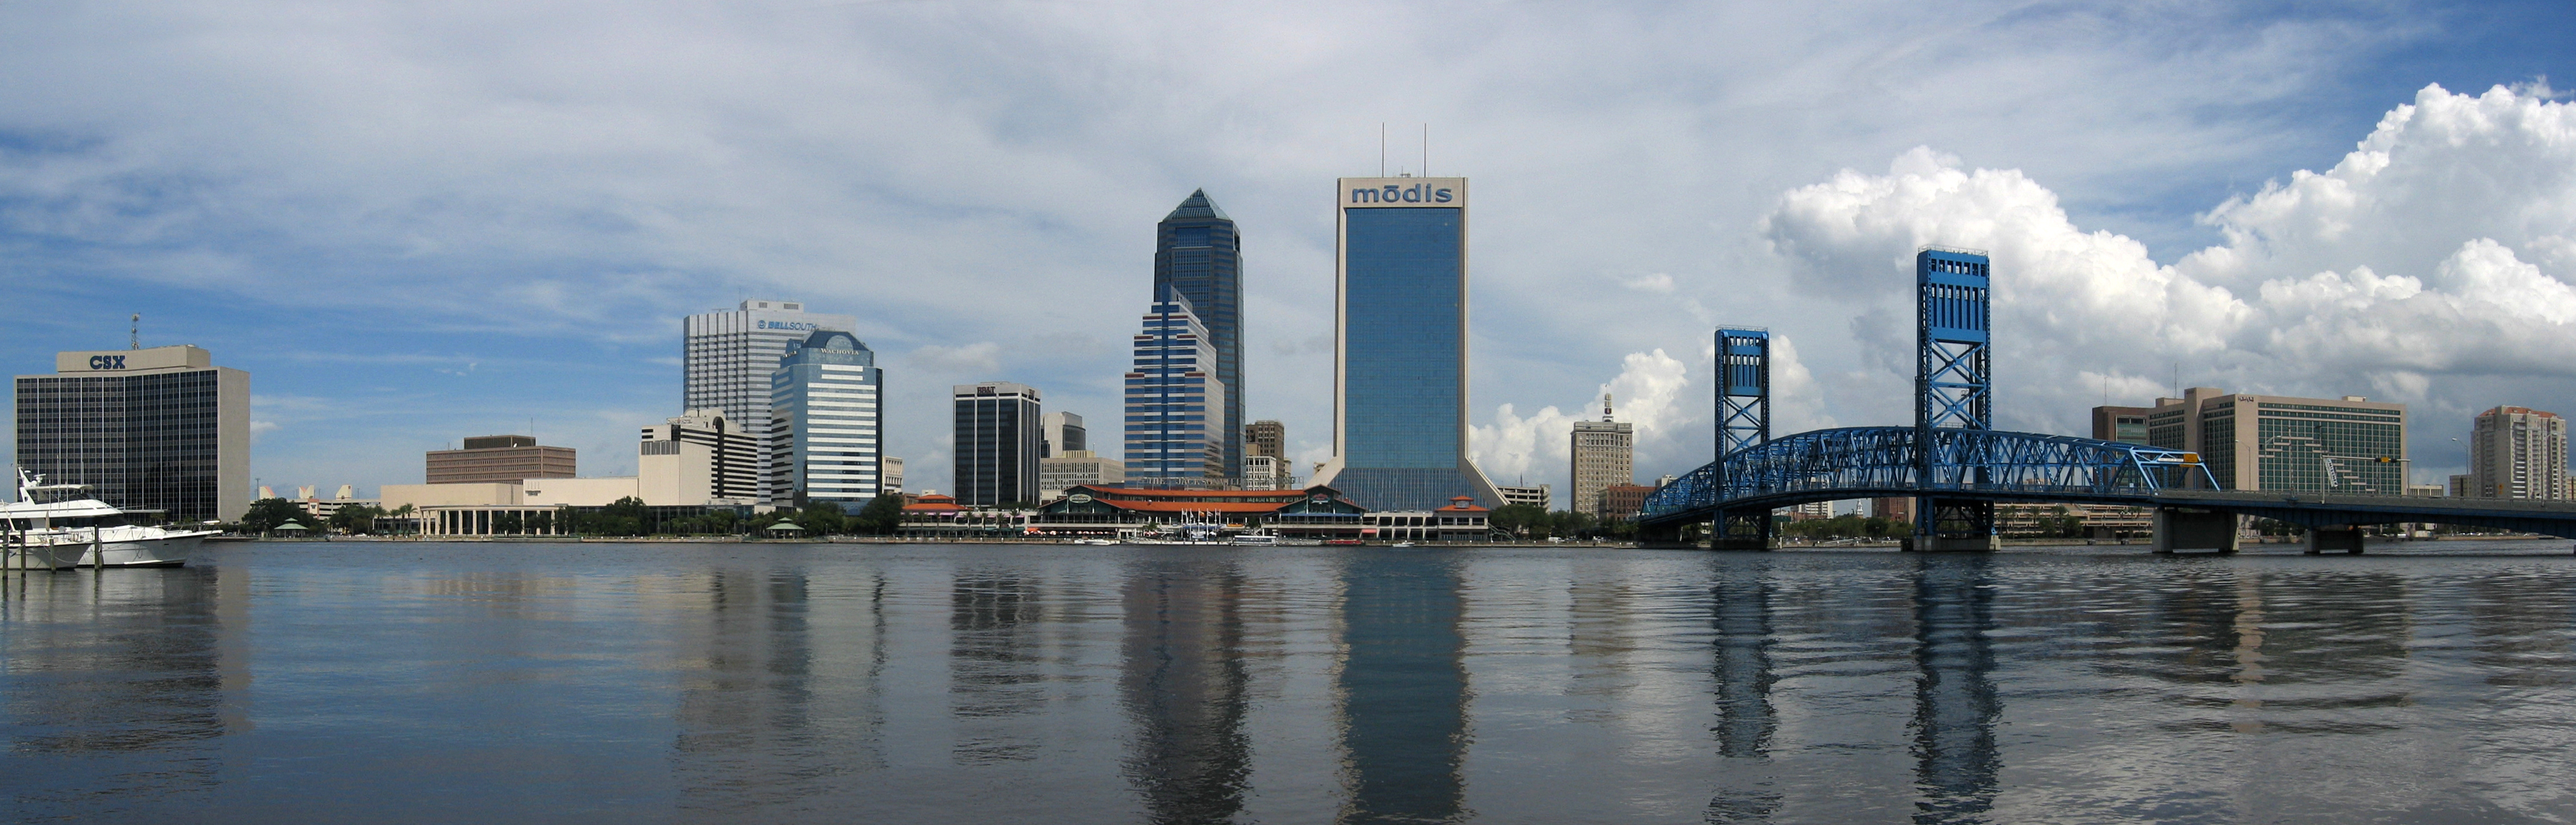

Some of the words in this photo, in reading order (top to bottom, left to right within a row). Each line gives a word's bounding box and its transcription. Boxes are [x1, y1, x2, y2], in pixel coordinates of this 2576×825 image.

[768, 321, 817, 331] BELLSOUTH
[89, 355, 126, 370] CSX
[1176, 476, 1247, 485] JACKSONVILL
